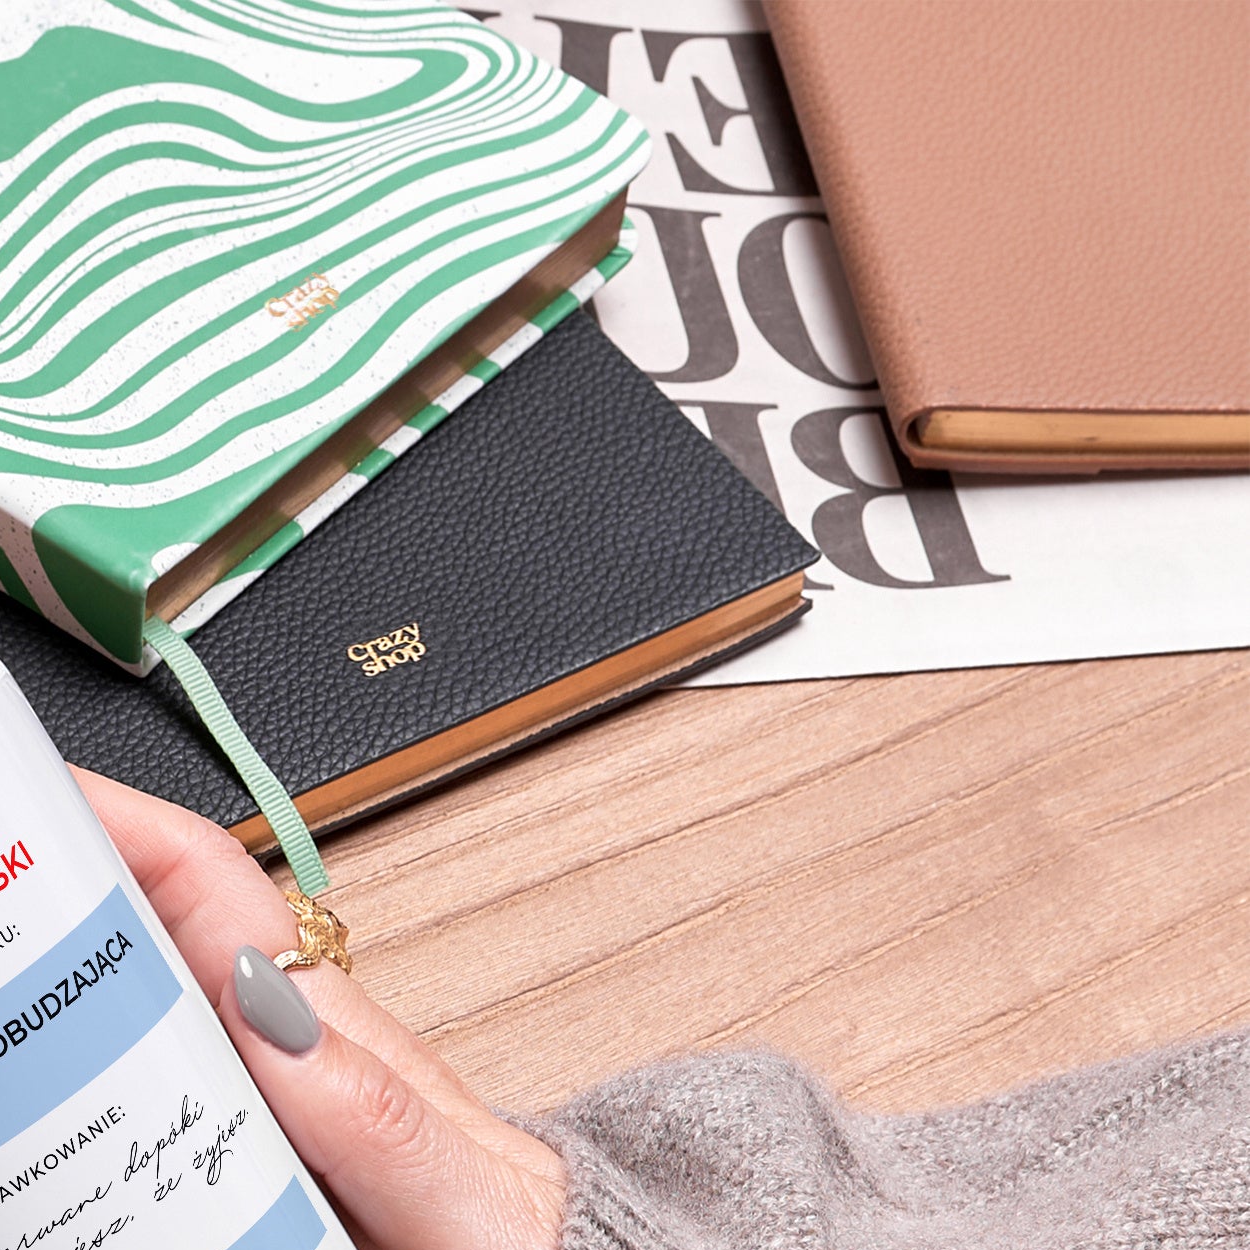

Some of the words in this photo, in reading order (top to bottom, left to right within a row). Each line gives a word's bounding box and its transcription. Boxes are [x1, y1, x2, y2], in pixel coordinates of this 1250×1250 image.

[347, 622, 420, 662] crazy
[361, 641, 427, 677] shop
[124, 1094, 204, 1183] dopóki
[153, 1172, 183, 1202] że
